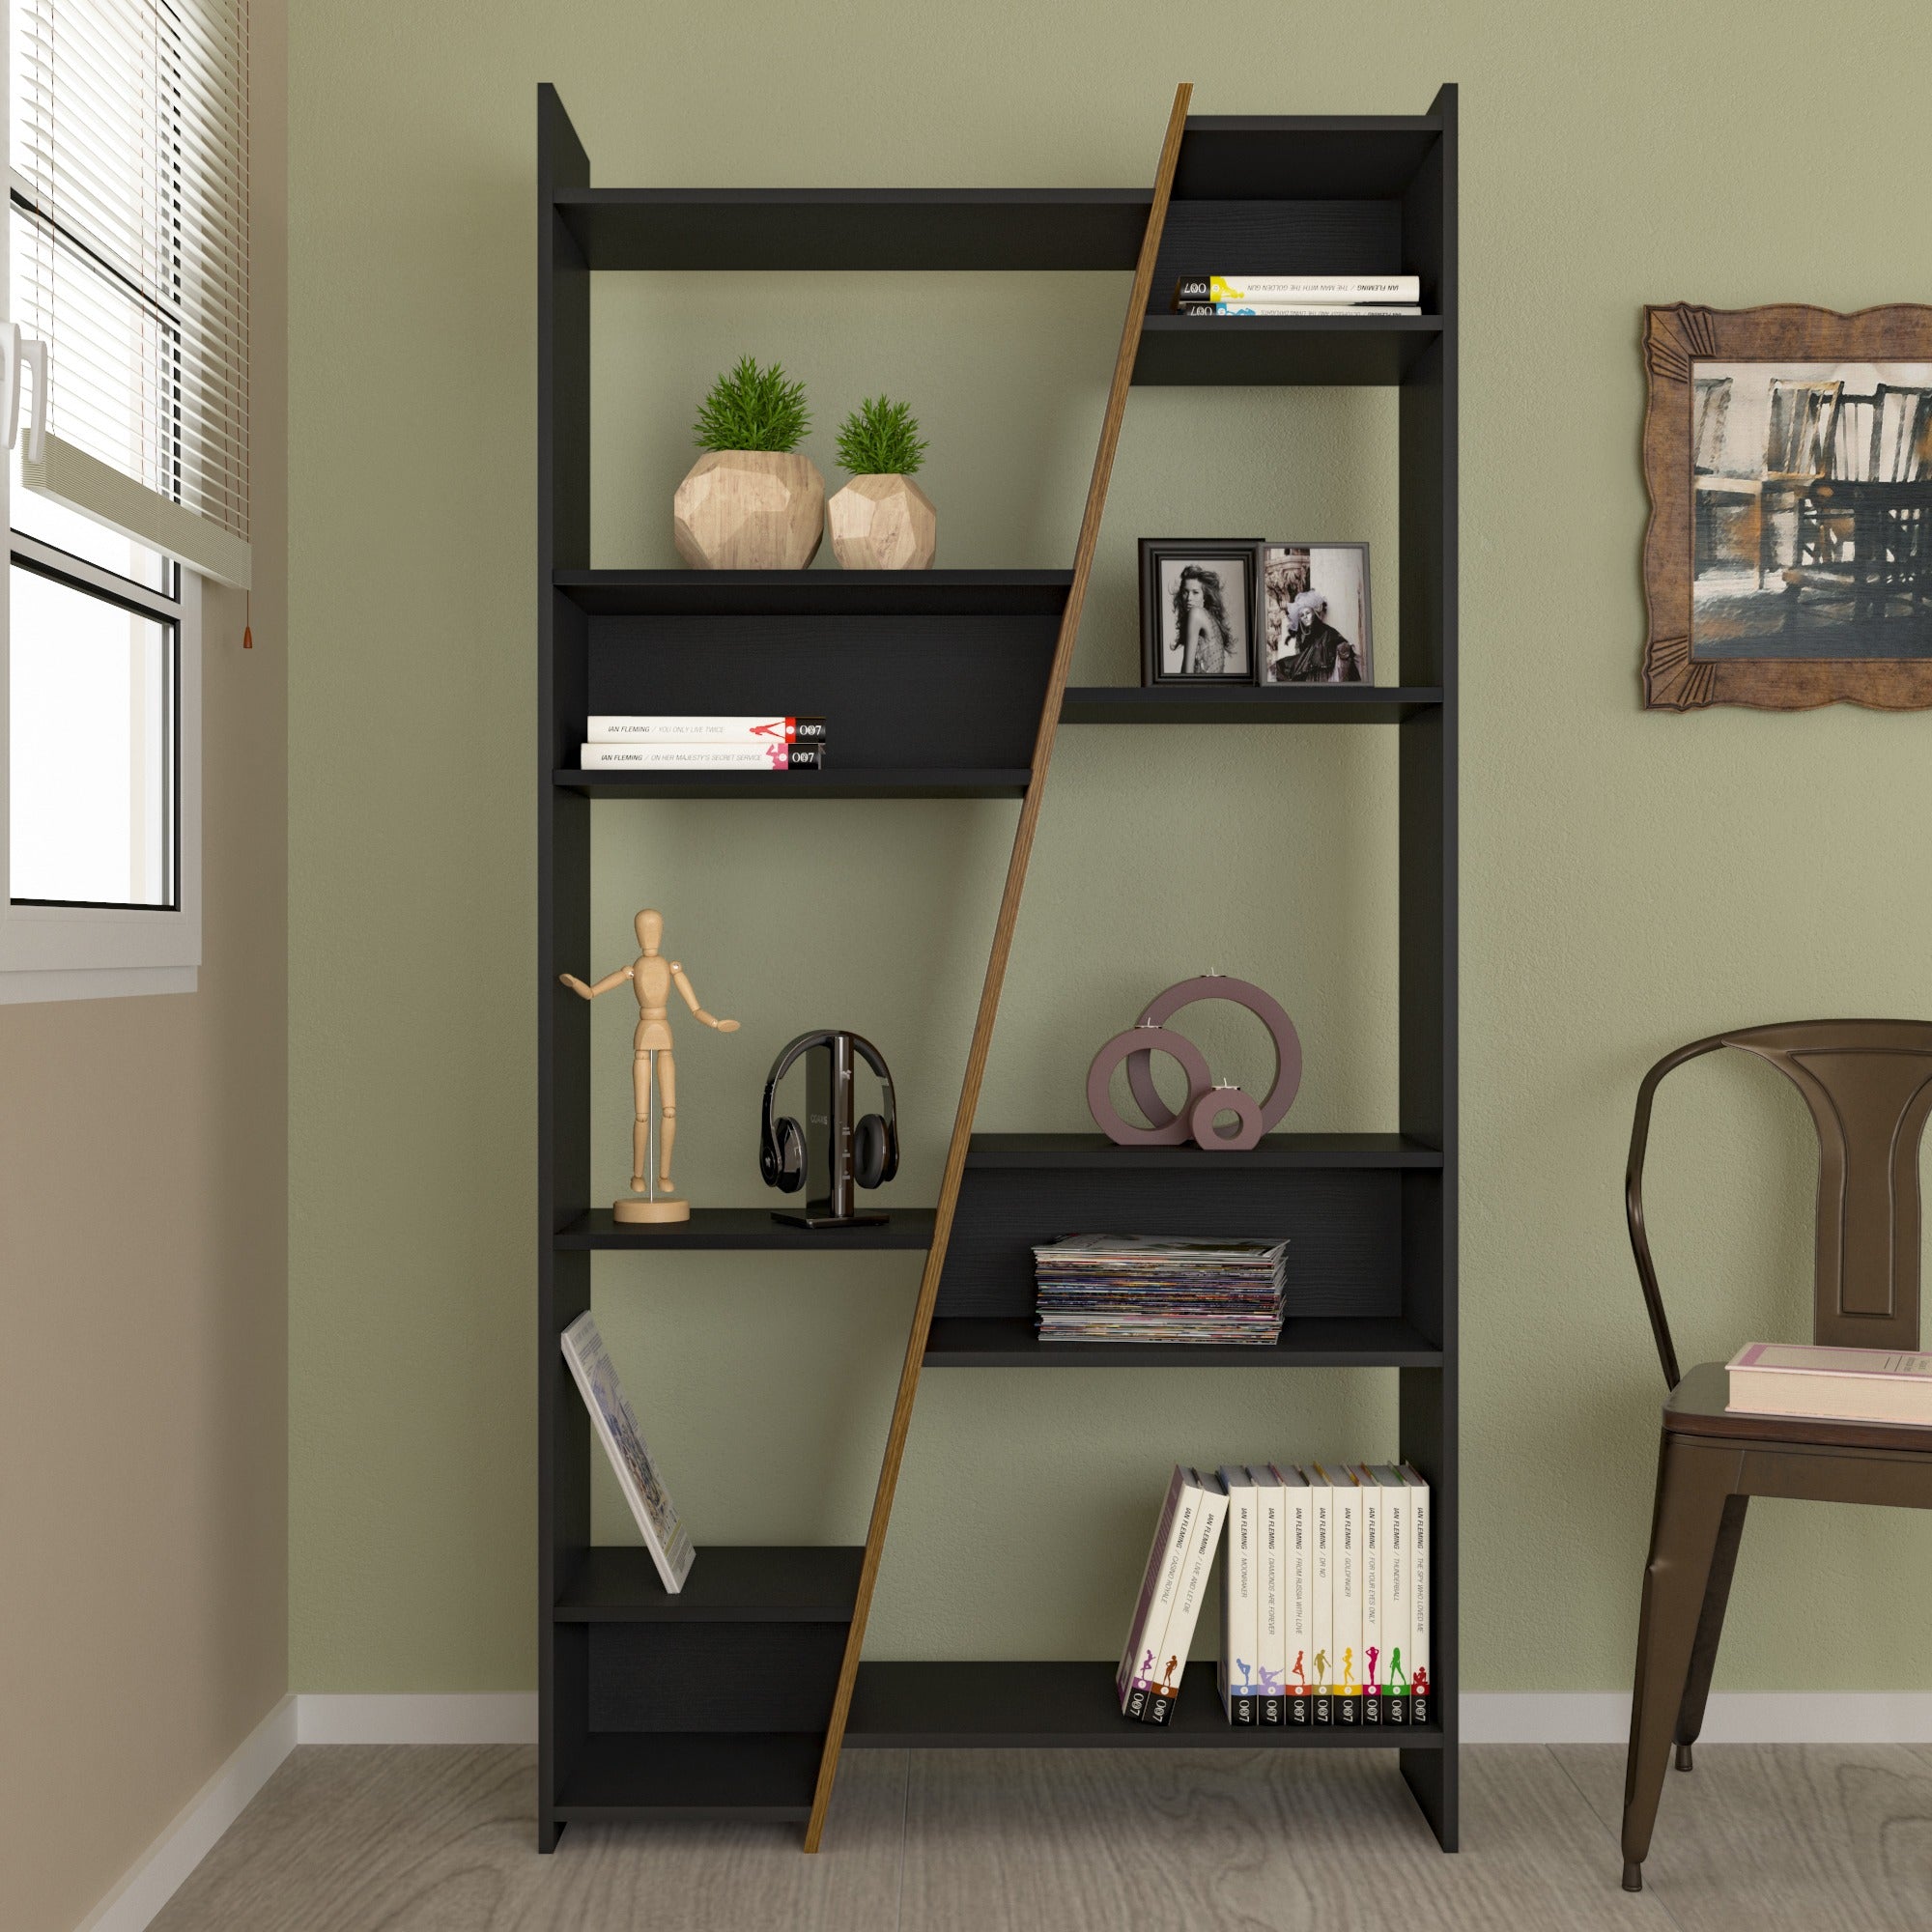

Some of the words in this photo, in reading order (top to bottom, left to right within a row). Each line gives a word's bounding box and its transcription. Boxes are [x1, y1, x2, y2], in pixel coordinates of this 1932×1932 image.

[1184, 282, 1207, 294] 007
[799, 725, 821, 735] 007
[792, 753, 814, 763] 007
[1176, 1520, 1188, 1548] FLEMING
[1198, 1526, 1210, 1554] FLEMING
[1168, 1556, 1179, 1579] CASINO
[1320, 1558, 1325, 1567] DR
[1320, 1568, 1325, 1577] NO
[1160, 1580, 1172, 1605] ROYALE
[1417, 1623, 1423, 1633] ME
[1130, 1693, 1144, 1717] 007
[1152, 1699, 1167, 1722] 007
[1238, 1700, 1249, 1722] 007
[1266, 1700, 1277, 1722] 007
[1294, 1700, 1304, 1722] 007
[1318, 1700, 1328, 1722] 007
[1343, 1700, 1353, 1722] 007
[1367, 1700, 1378, 1721] 007
[1392, 1700, 1402, 1722] 007
[1415, 1699, 1426, 1721] 007
